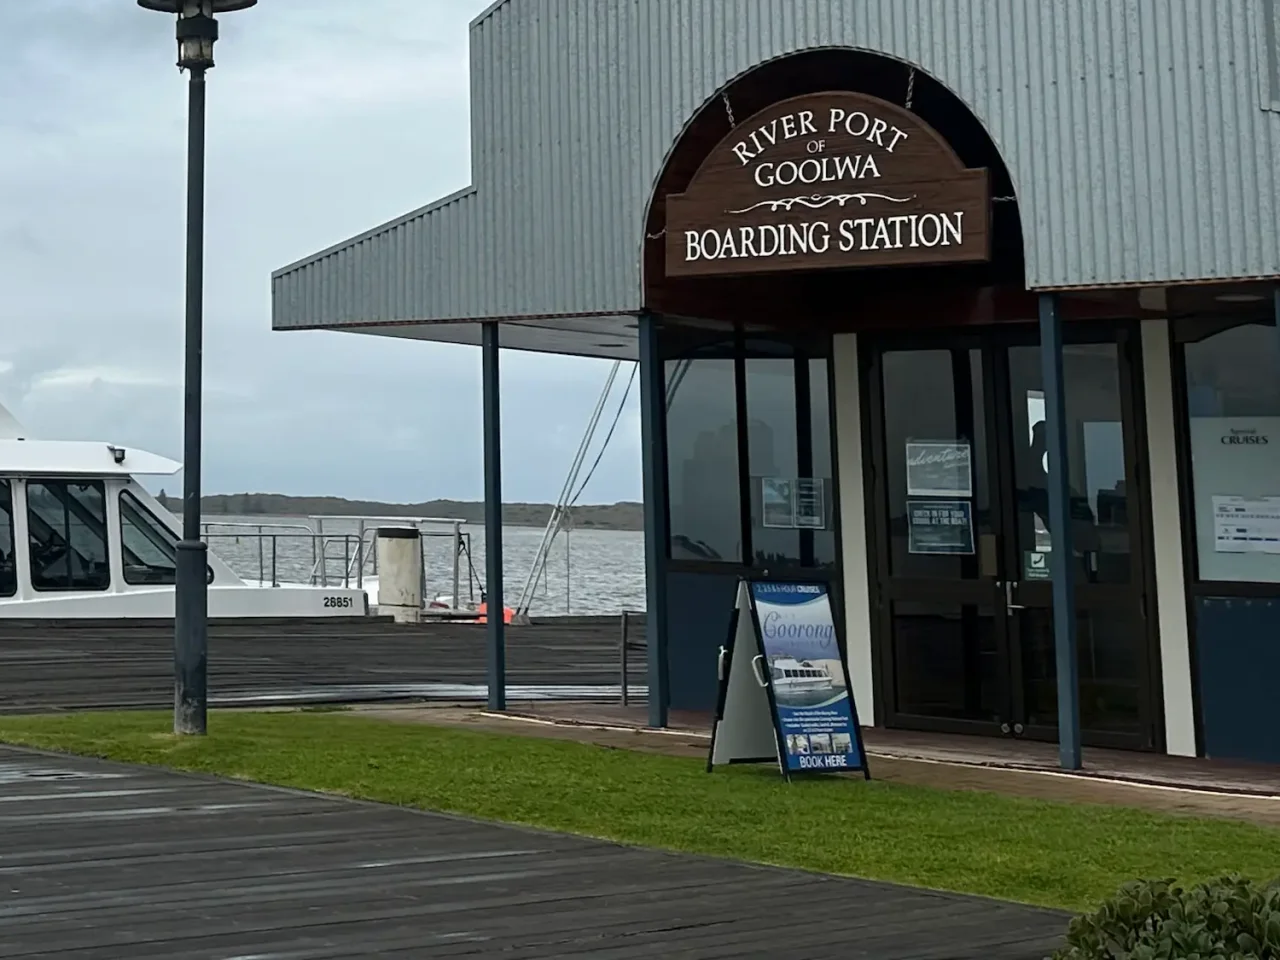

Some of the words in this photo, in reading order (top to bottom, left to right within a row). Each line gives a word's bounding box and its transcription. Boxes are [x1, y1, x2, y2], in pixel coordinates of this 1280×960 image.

[732, 110, 817, 166] RIVER
[828, 108, 908, 152] PORT
[806, 139, 826, 153] OF
[754, 153, 881, 187] GOOLWA
[684, 221, 831, 261] BOARDING
[838, 211, 964, 252] STATION
[1220, 435, 1269, 445] CRUISES
[323, 596, 353, 608] 28851
[799, 755, 824, 768] BOOK
[824, 755, 848, 767] HERE
